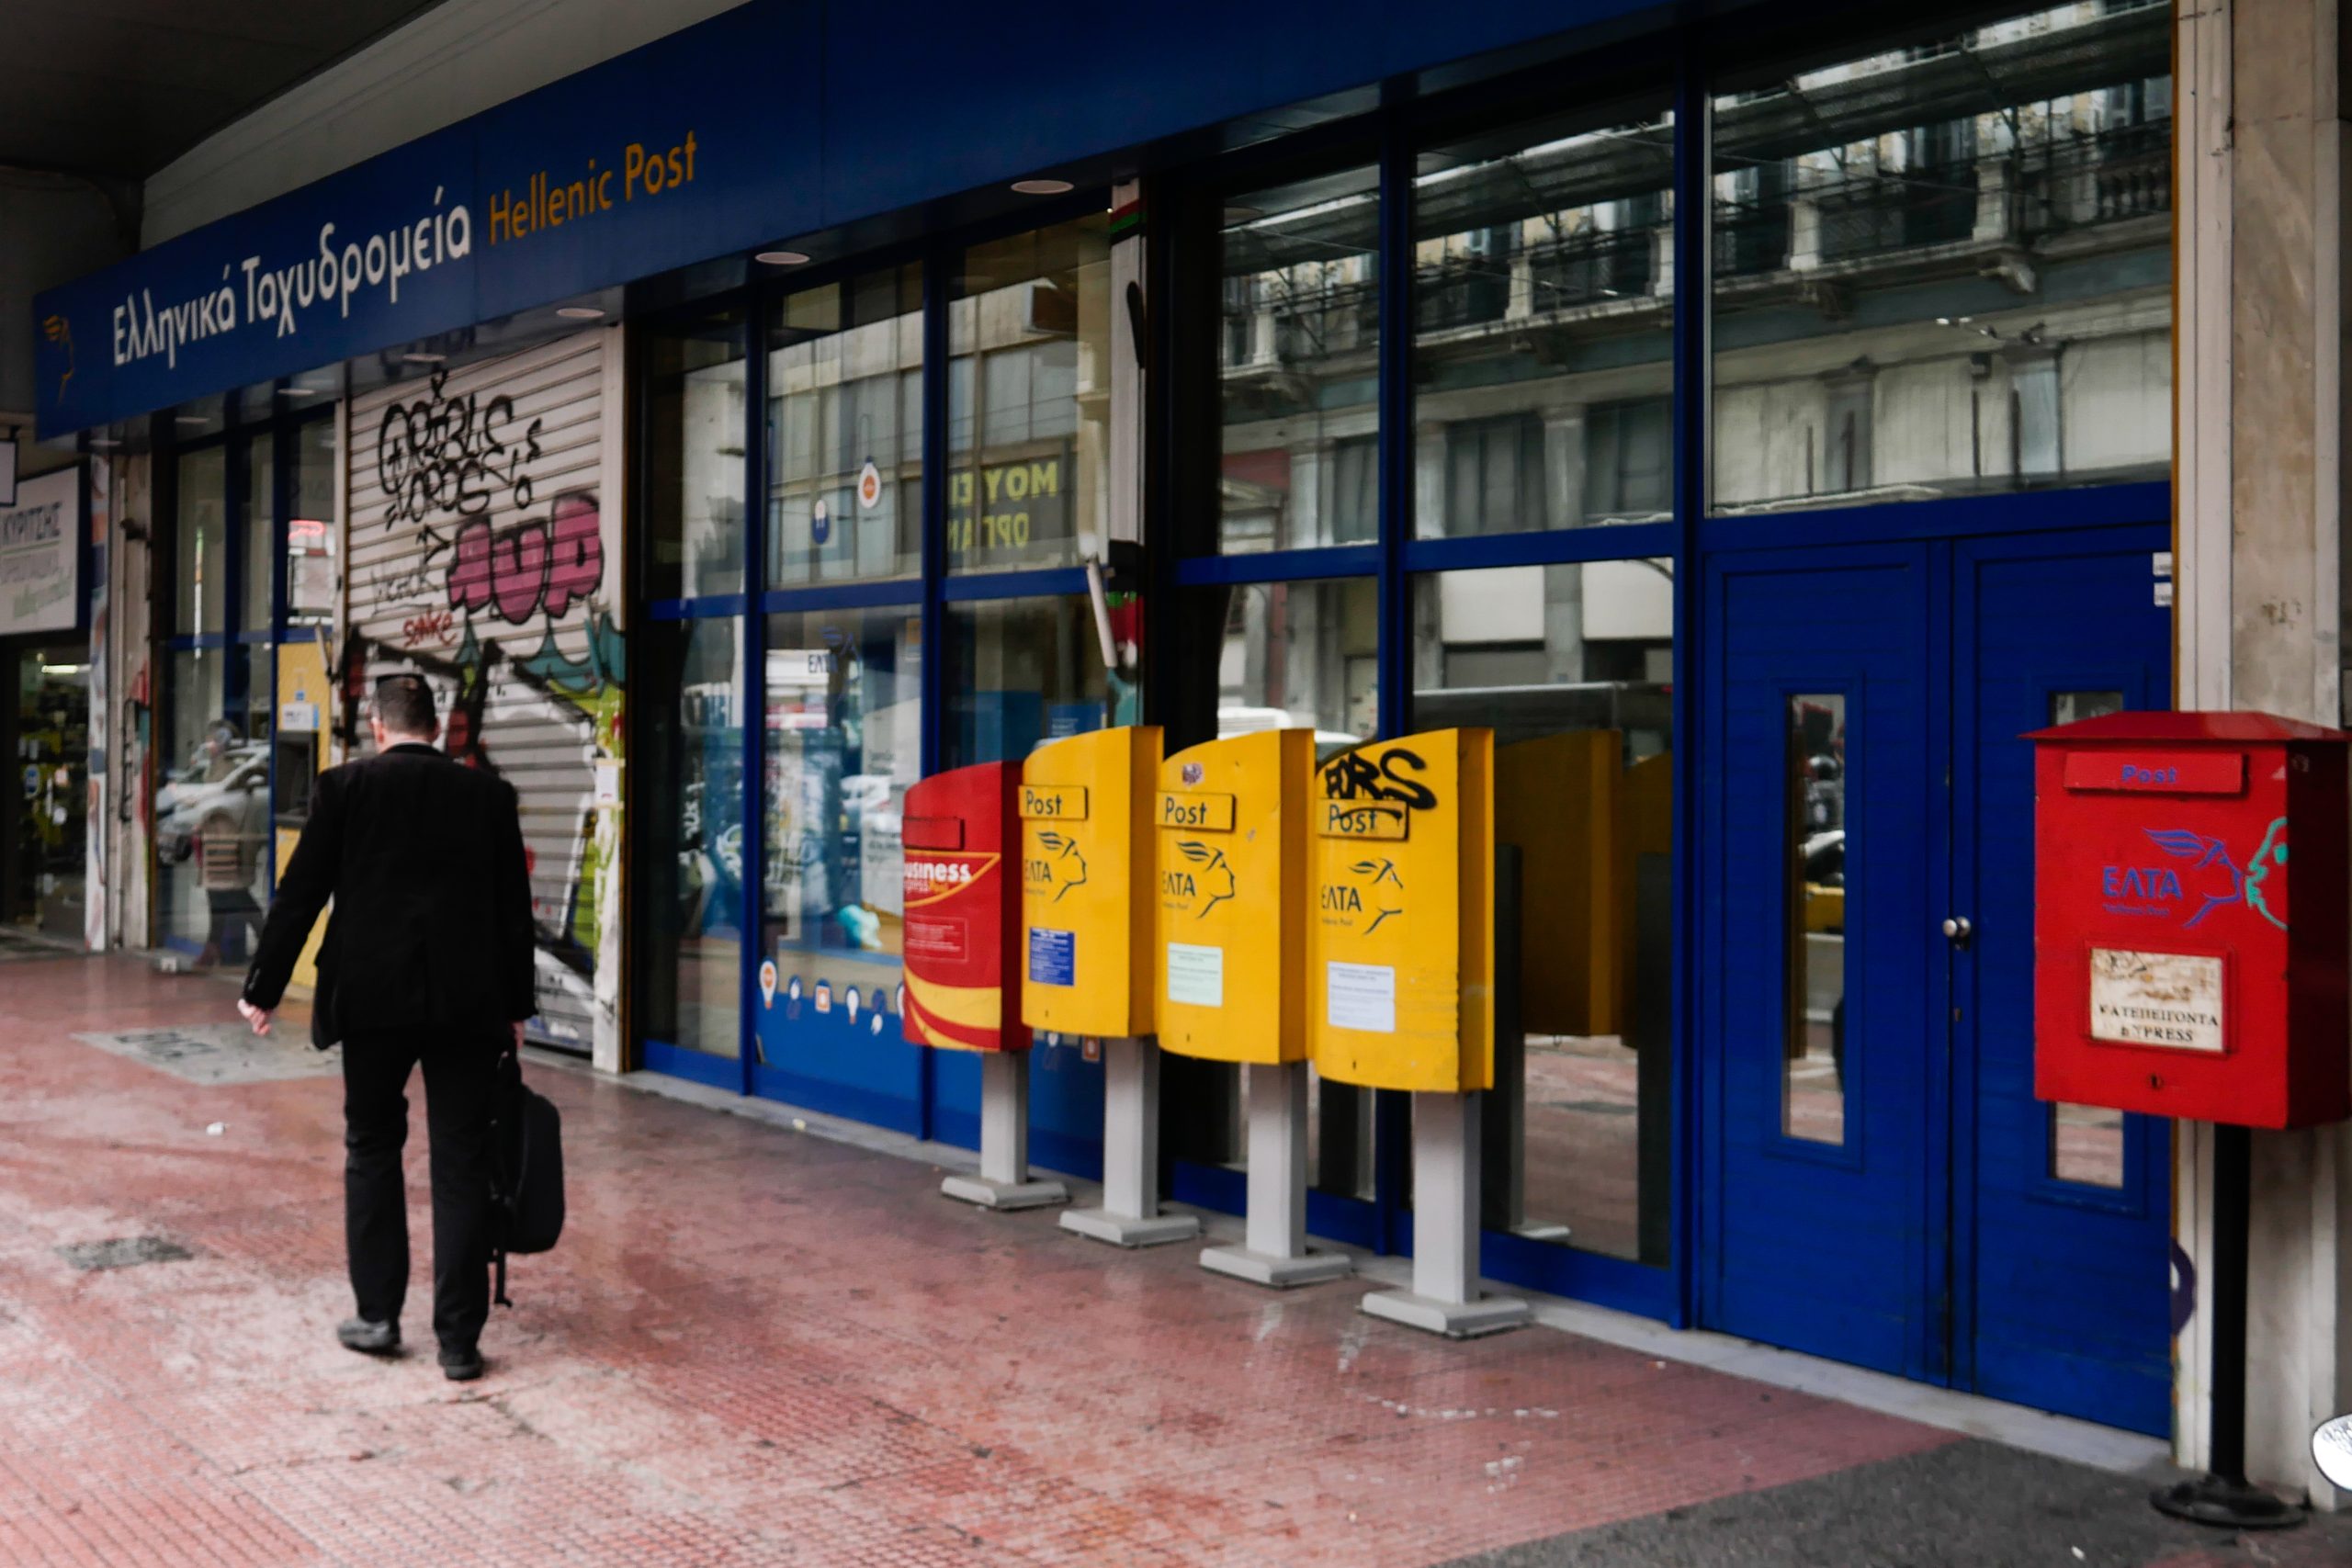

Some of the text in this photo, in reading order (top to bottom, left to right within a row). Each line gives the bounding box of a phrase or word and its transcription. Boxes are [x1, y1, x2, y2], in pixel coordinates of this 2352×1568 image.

[489, 130, 697, 246] Hellenic Post
[113, 185, 471, 370] Ελληνικά Ταχυδρομεία
[2122, 764, 2177, 784] Post
[1025, 789, 1062, 816] Post
[1165, 796, 1206, 825] Post
[1329, 804, 1377, 833] Post
[1025, 859, 1052, 883] ΕΛΤΑ
[1162, 871, 1196, 897] ΕΛΤΑ
[2103, 866, 2183, 901] ΕΛΤΑ
[1322, 884, 1363, 912] ΕΛΤΑ
